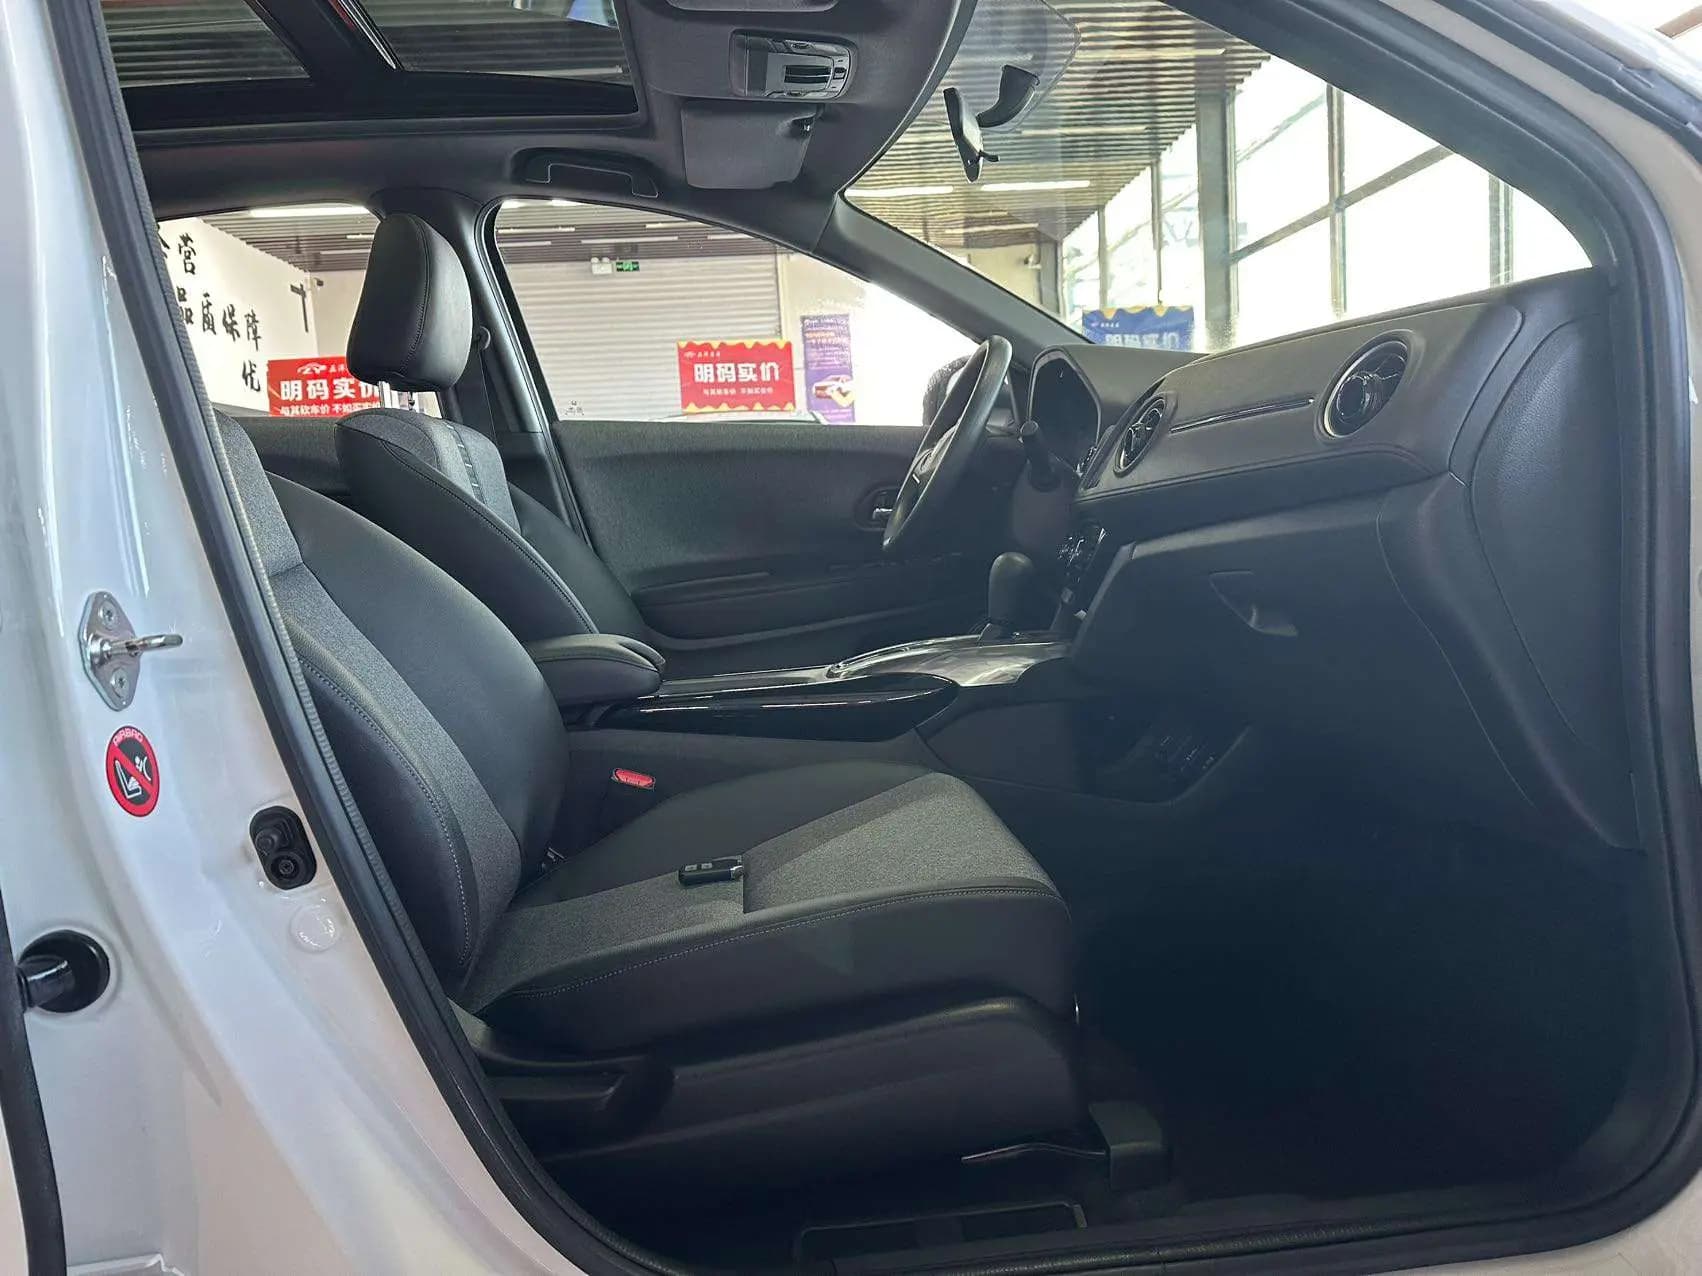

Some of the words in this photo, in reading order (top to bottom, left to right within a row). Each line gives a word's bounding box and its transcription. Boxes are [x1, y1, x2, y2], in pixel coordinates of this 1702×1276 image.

[694, 361, 780, 383] 明码实价
[280, 378, 380, 402] 明码实价
